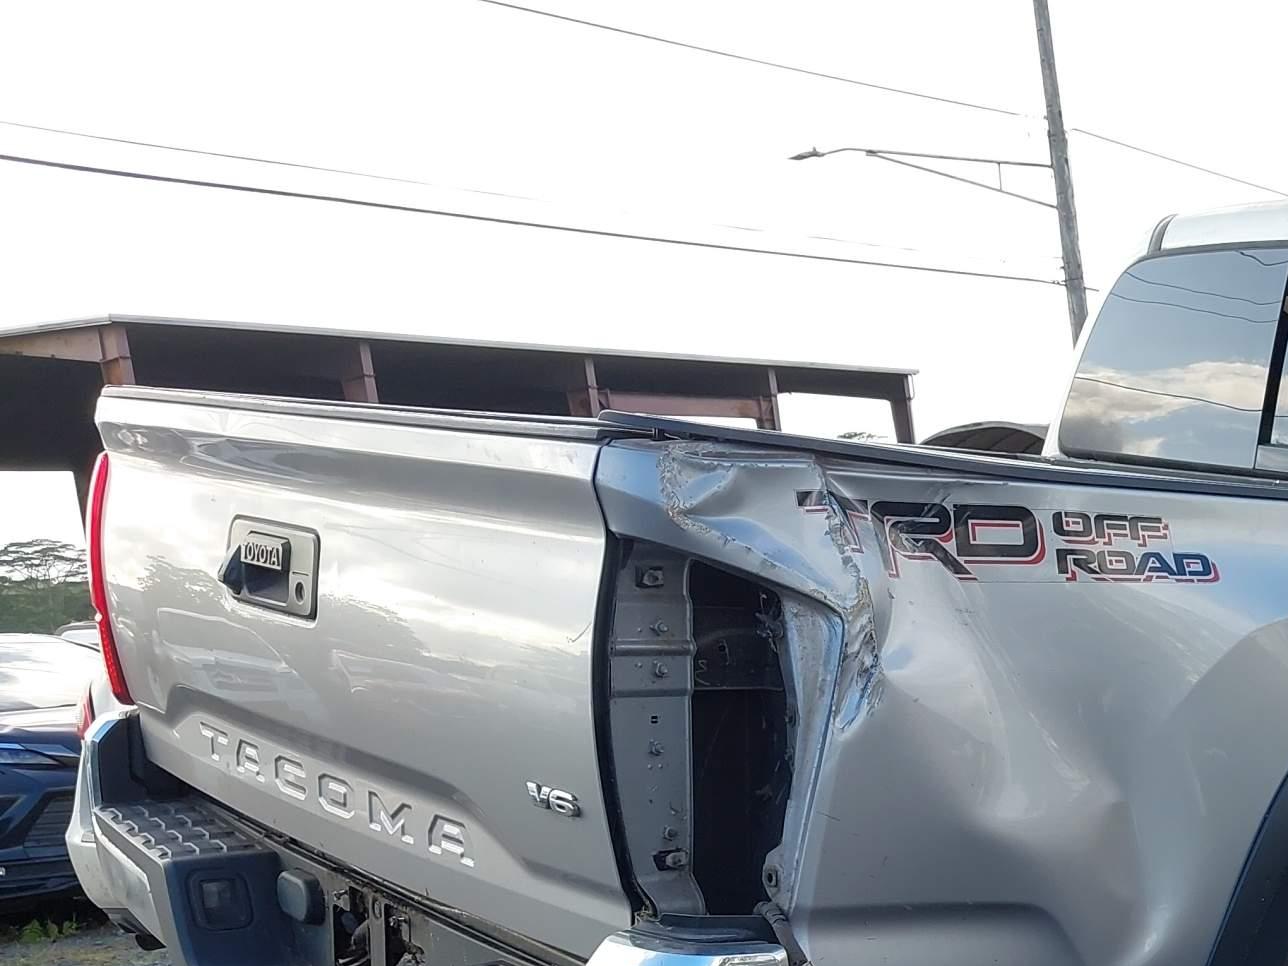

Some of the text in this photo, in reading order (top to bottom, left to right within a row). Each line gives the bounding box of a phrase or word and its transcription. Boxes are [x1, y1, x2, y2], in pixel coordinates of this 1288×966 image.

[794, 488, 1046, 581] TRD
[1051, 510, 1170, 548] OFF
[242, 541, 281, 567] TOYOTA
[1056, 548, 1221, 584] ROAD
[199, 721, 475, 868] TACOMA
[526, 780, 583, 818] V6
